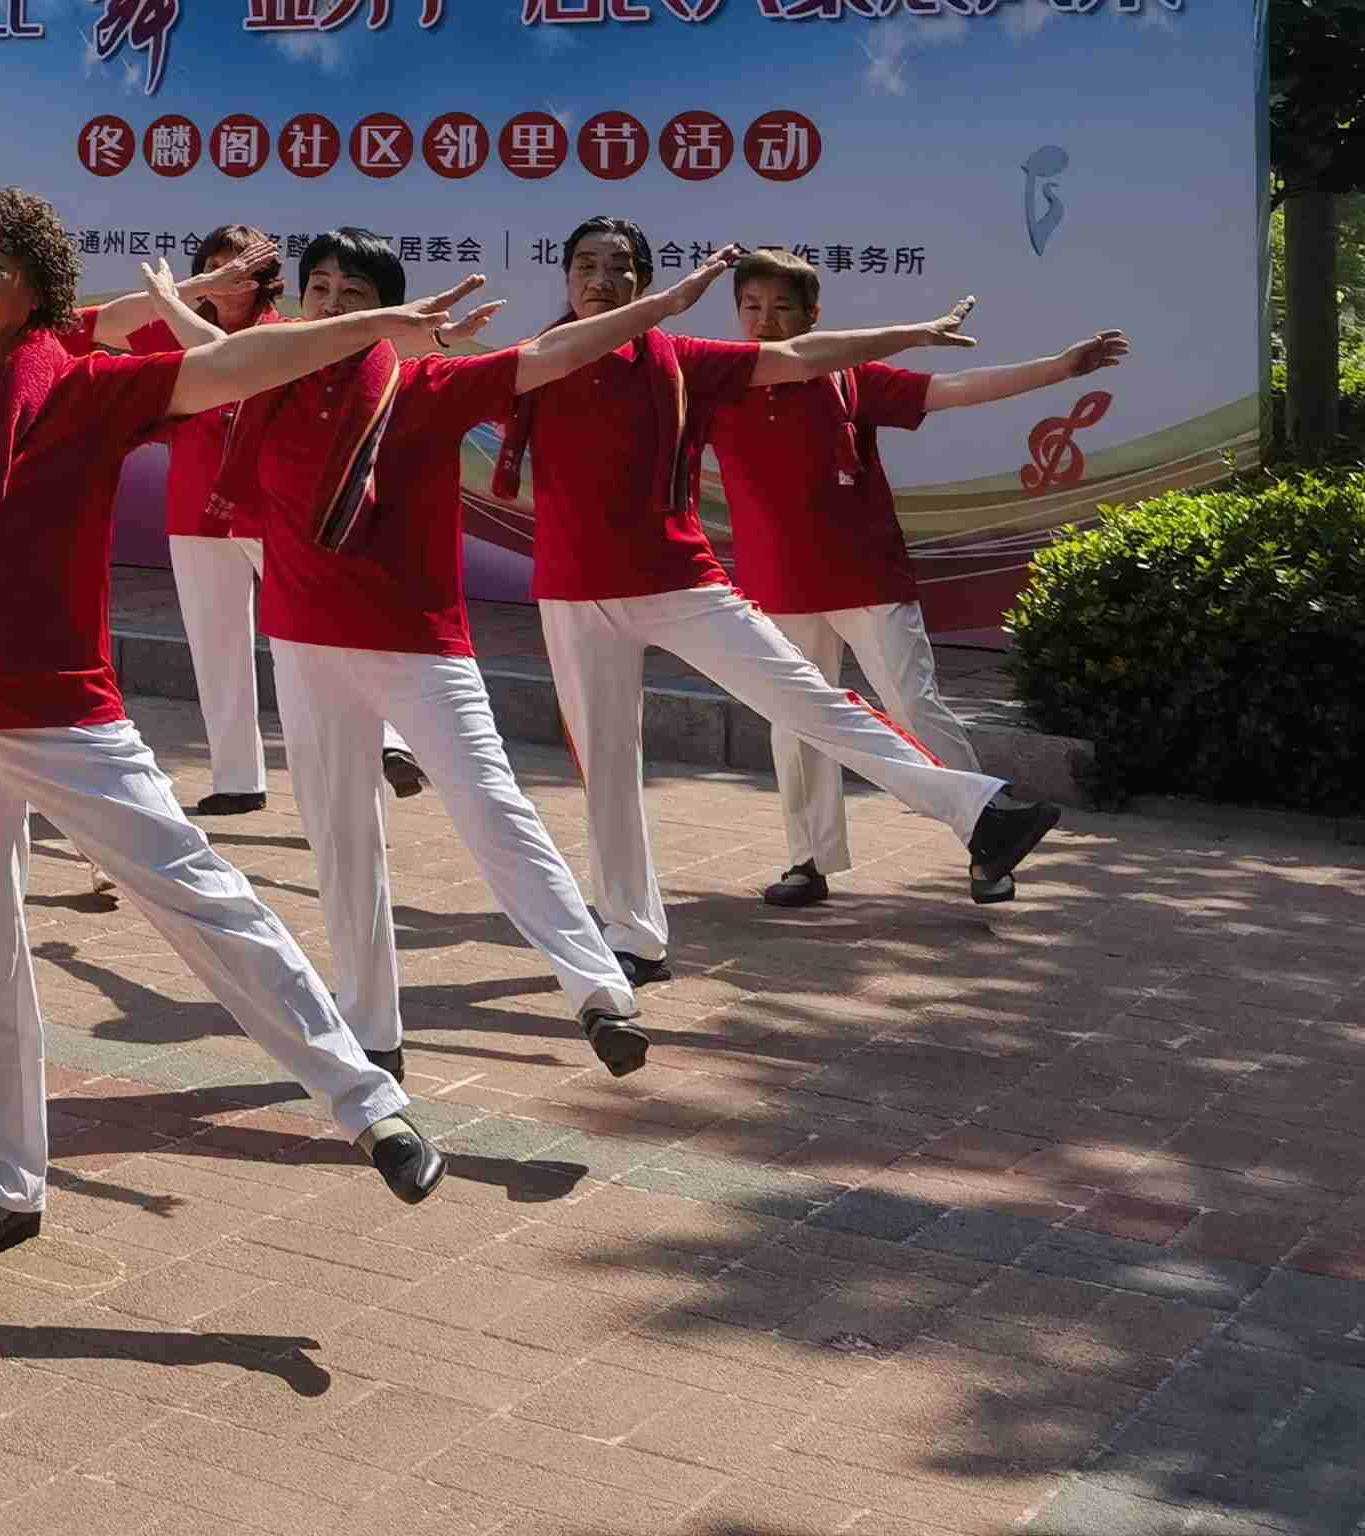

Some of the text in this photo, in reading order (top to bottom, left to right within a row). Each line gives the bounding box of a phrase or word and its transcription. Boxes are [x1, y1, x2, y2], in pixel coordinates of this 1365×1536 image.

[86, 121, 809, 172] 佟麟阁社区邻里节活动
